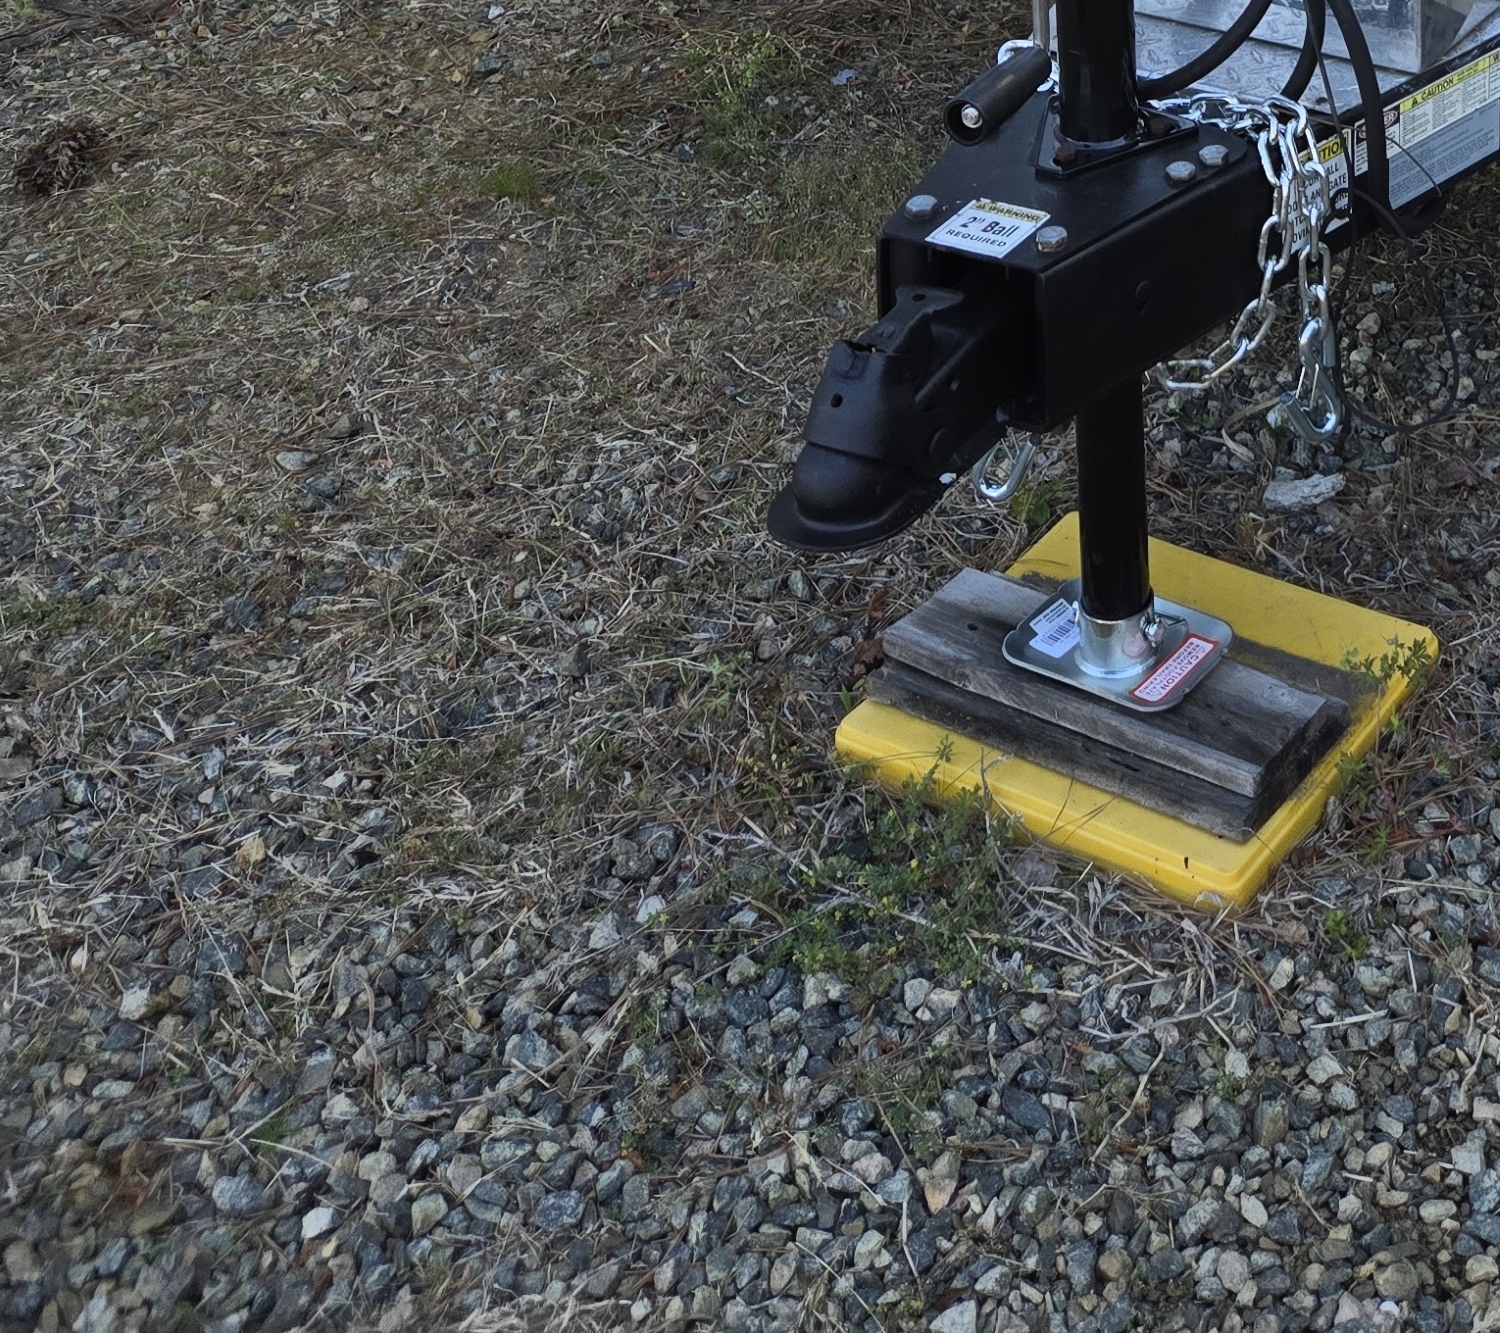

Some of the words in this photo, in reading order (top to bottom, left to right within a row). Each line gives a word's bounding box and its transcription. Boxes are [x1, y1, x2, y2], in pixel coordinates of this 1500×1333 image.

[1421, 77, 1454, 100] CAUTION
[989, 204, 1041, 222] WARNING
[945, 228, 1007, 247] REQUIRED
[981, 220, 1020, 238] Ball
[1160, 654, 1199, 691] CAUTION
